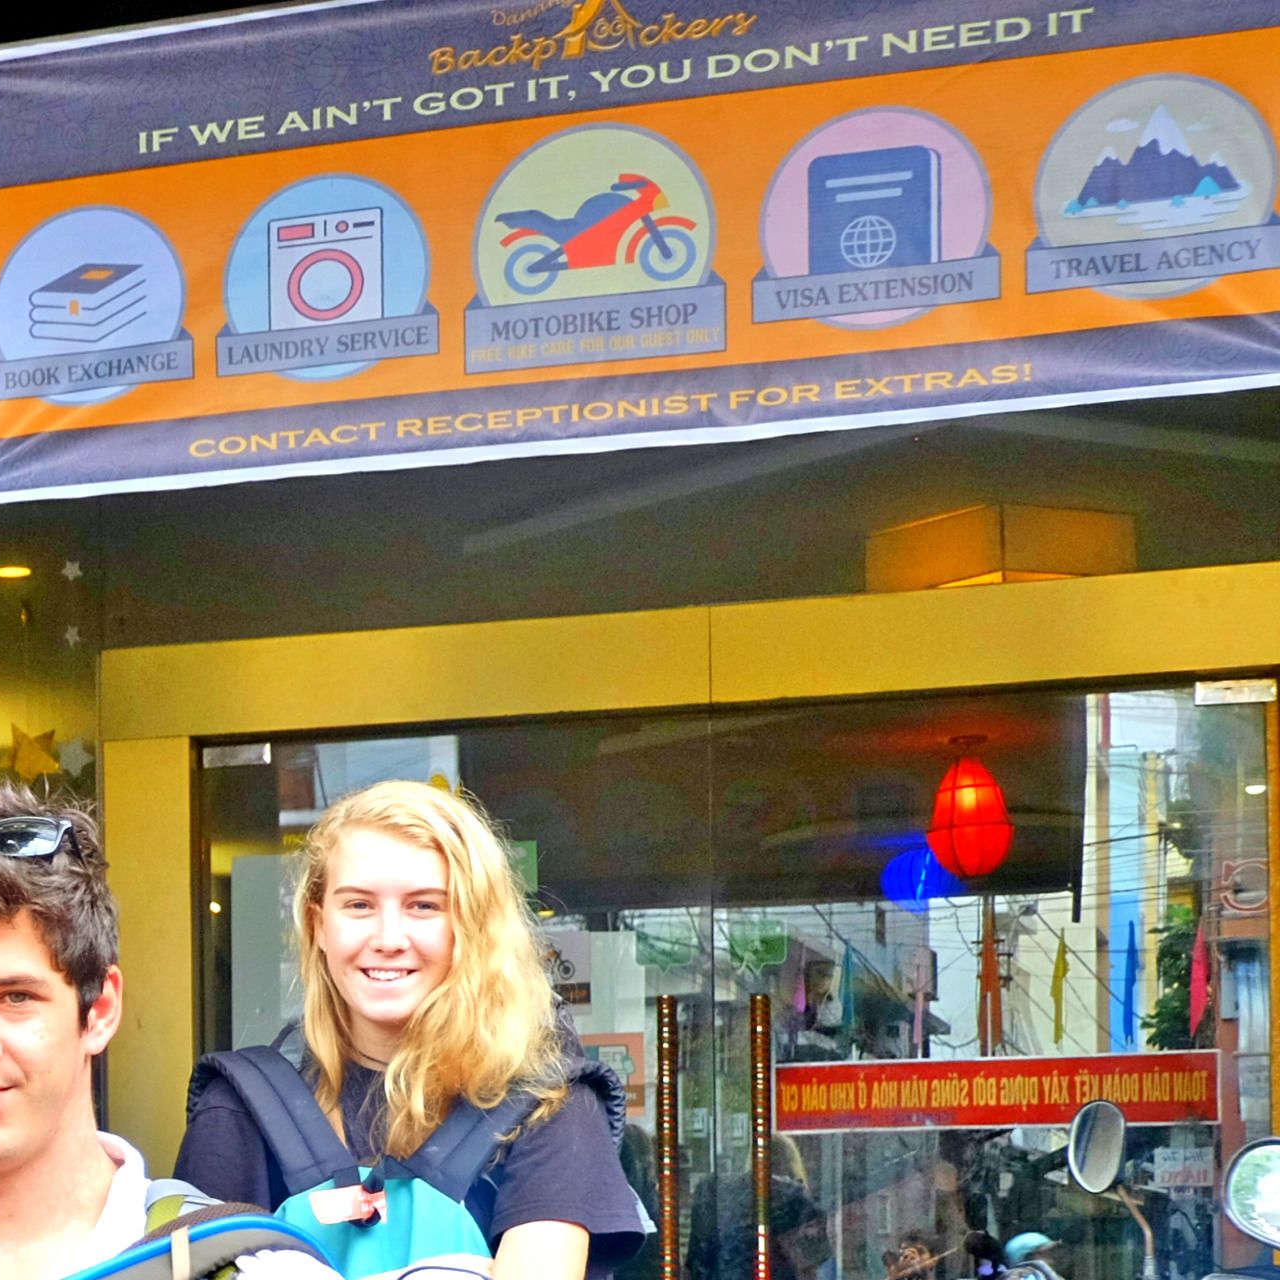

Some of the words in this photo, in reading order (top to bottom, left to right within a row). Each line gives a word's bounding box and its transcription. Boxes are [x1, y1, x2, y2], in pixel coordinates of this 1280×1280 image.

[138, 129, 176, 153] IF
[189, 115, 265, 145] WE
[278, 97, 402, 135] AIN'T
[413, 82, 514, 116] GOT
[527, 74, 577, 102] IT,
[590, 58, 691, 93] YOU
[706, 36, 868, 80] DON'T
[881, 16, 1031, 58] NEED
[1046, 7, 1094, 36] IT
[1051, 253, 1148, 281] TRAVEL
[1157, 237, 1262, 267] AGENCY
[776, 288, 831, 311] VISA
[837, 270, 974, 304] EXTENSION
[490, 310, 620, 342] MOTOBIKE
[630, 302, 698, 328] SHOP
[226, 334, 330, 366] LAUNDRY
[335, 325, 430, 351] SERVICE
[470, 347, 502, 364] FREE
[543, 340, 575, 356] CARE
[580, 336, 605, 352] FOR
[609, 333, 635, 349] OUR
[639, 330, 682, 347] GUEST
[686, 327, 721, 344] ONLY
[3, 365, 60, 390] BOOK
[66, 351, 179, 383] EXCHANGE
[188, 421, 386, 459] CONTACT
[397, 392, 717, 438] RECEPTIONIST
[729, 382, 821, 409] FOR
[834, 363, 1033, 400] EXTRAS!
